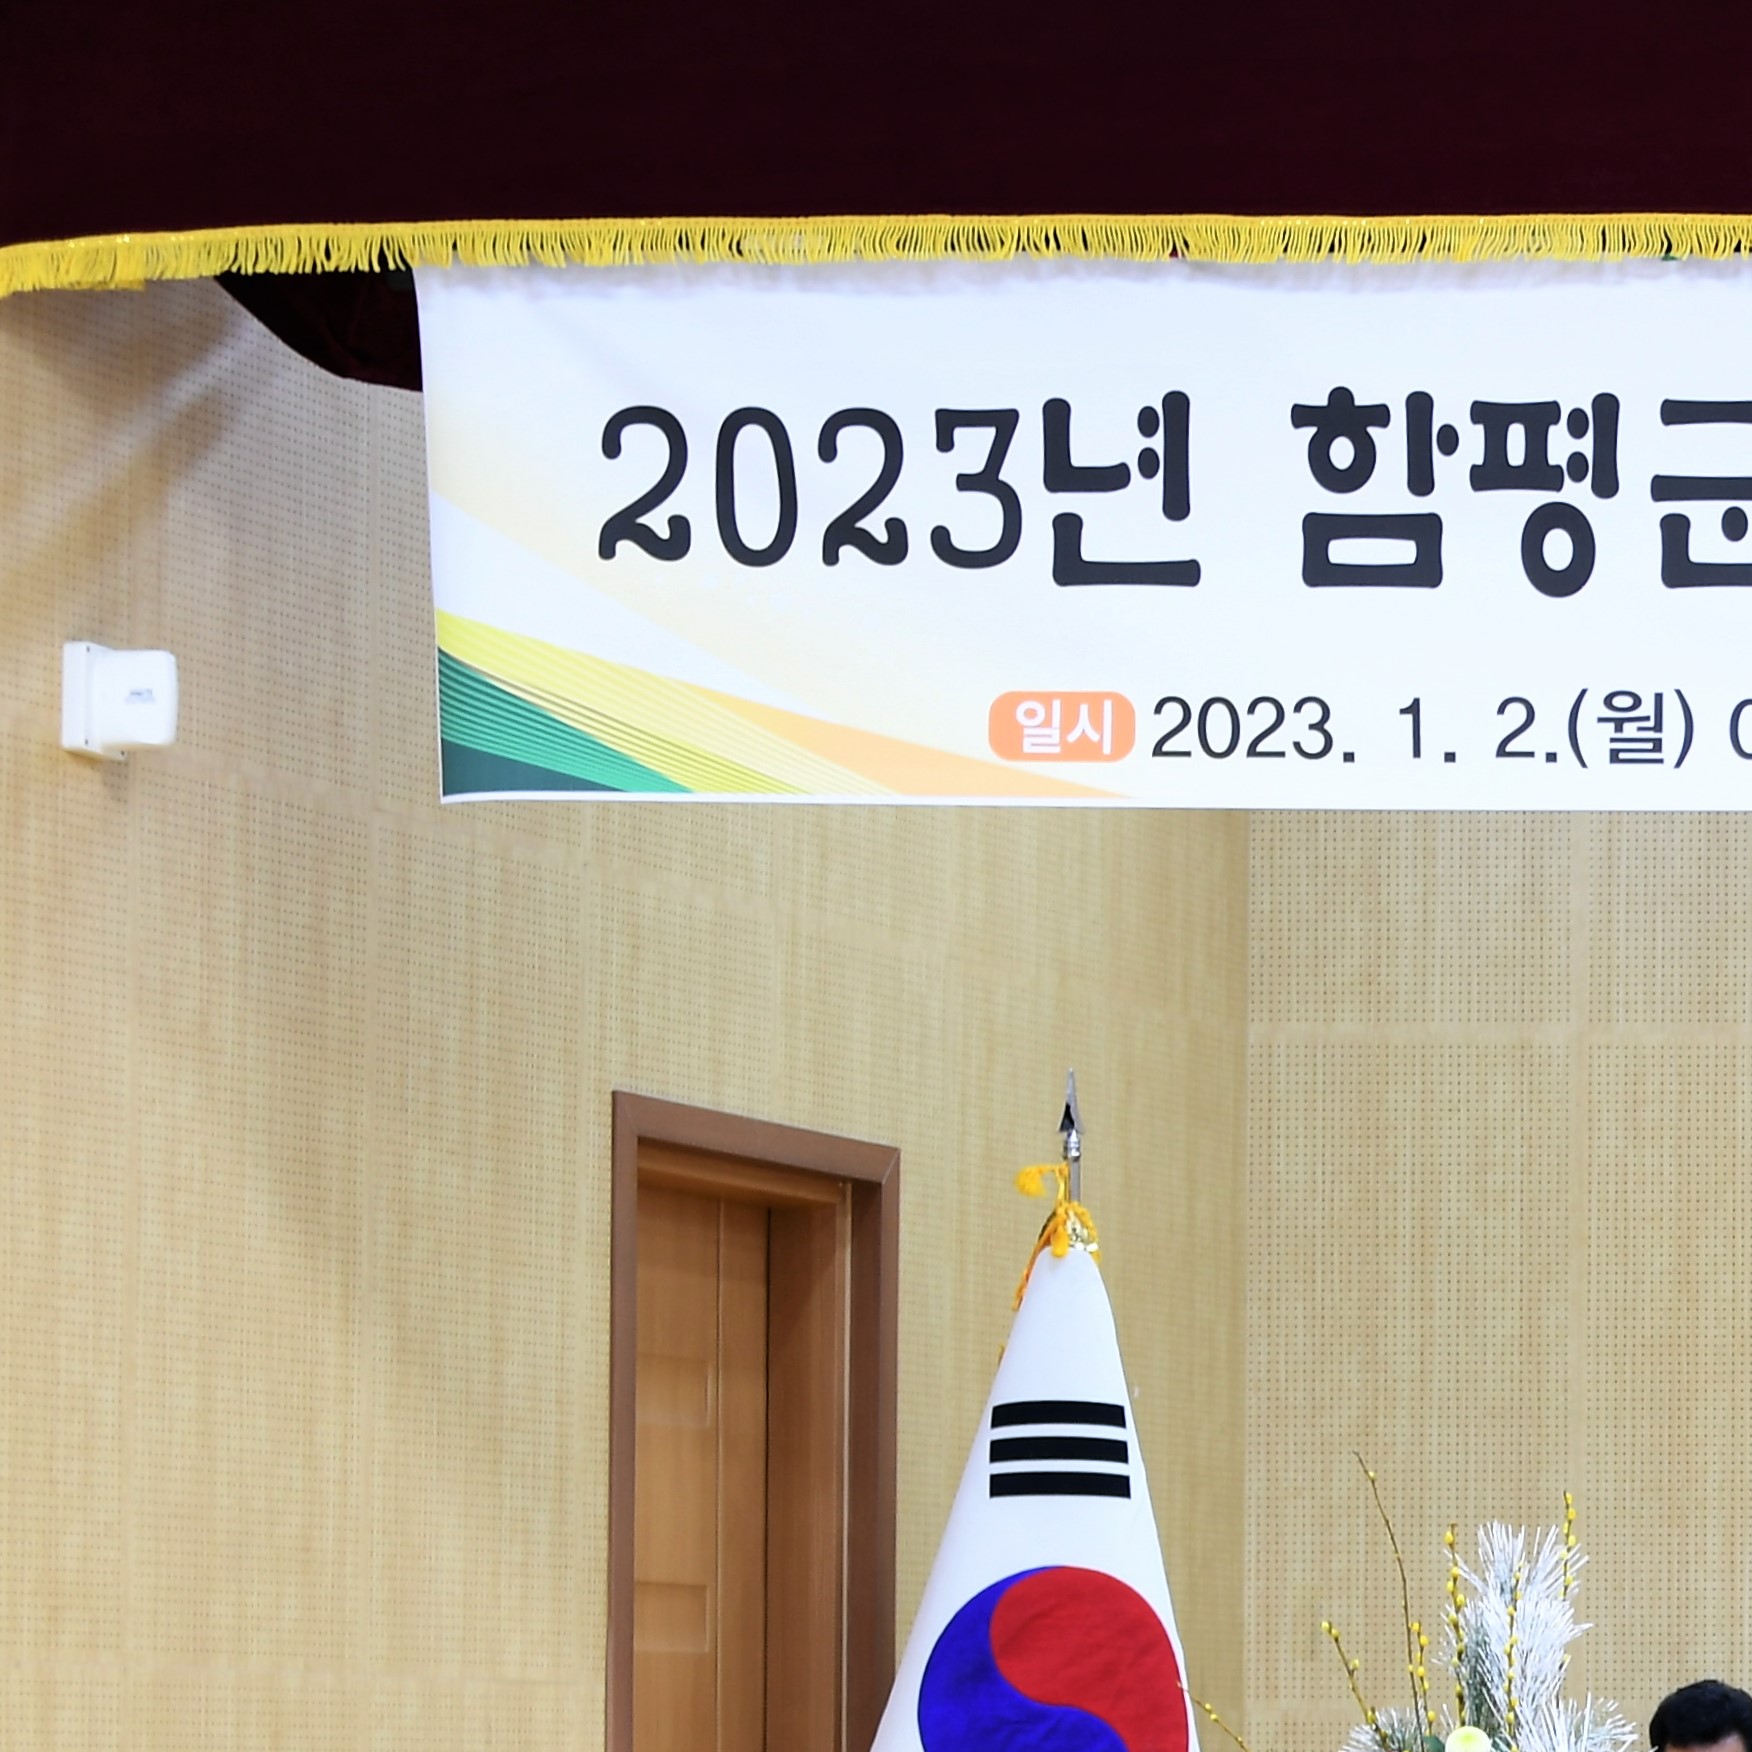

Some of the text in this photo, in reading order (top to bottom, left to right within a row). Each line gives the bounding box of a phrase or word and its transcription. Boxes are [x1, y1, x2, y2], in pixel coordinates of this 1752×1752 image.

[598, 390, 1202, 588] 2023년
[1014, 699, 1113, 756] 일시
[1151, 695, 1355, 763] 2023.
[1399, 697, 1456, 763] 1.
[1495, 688, 1694, 769] 2.(월)
